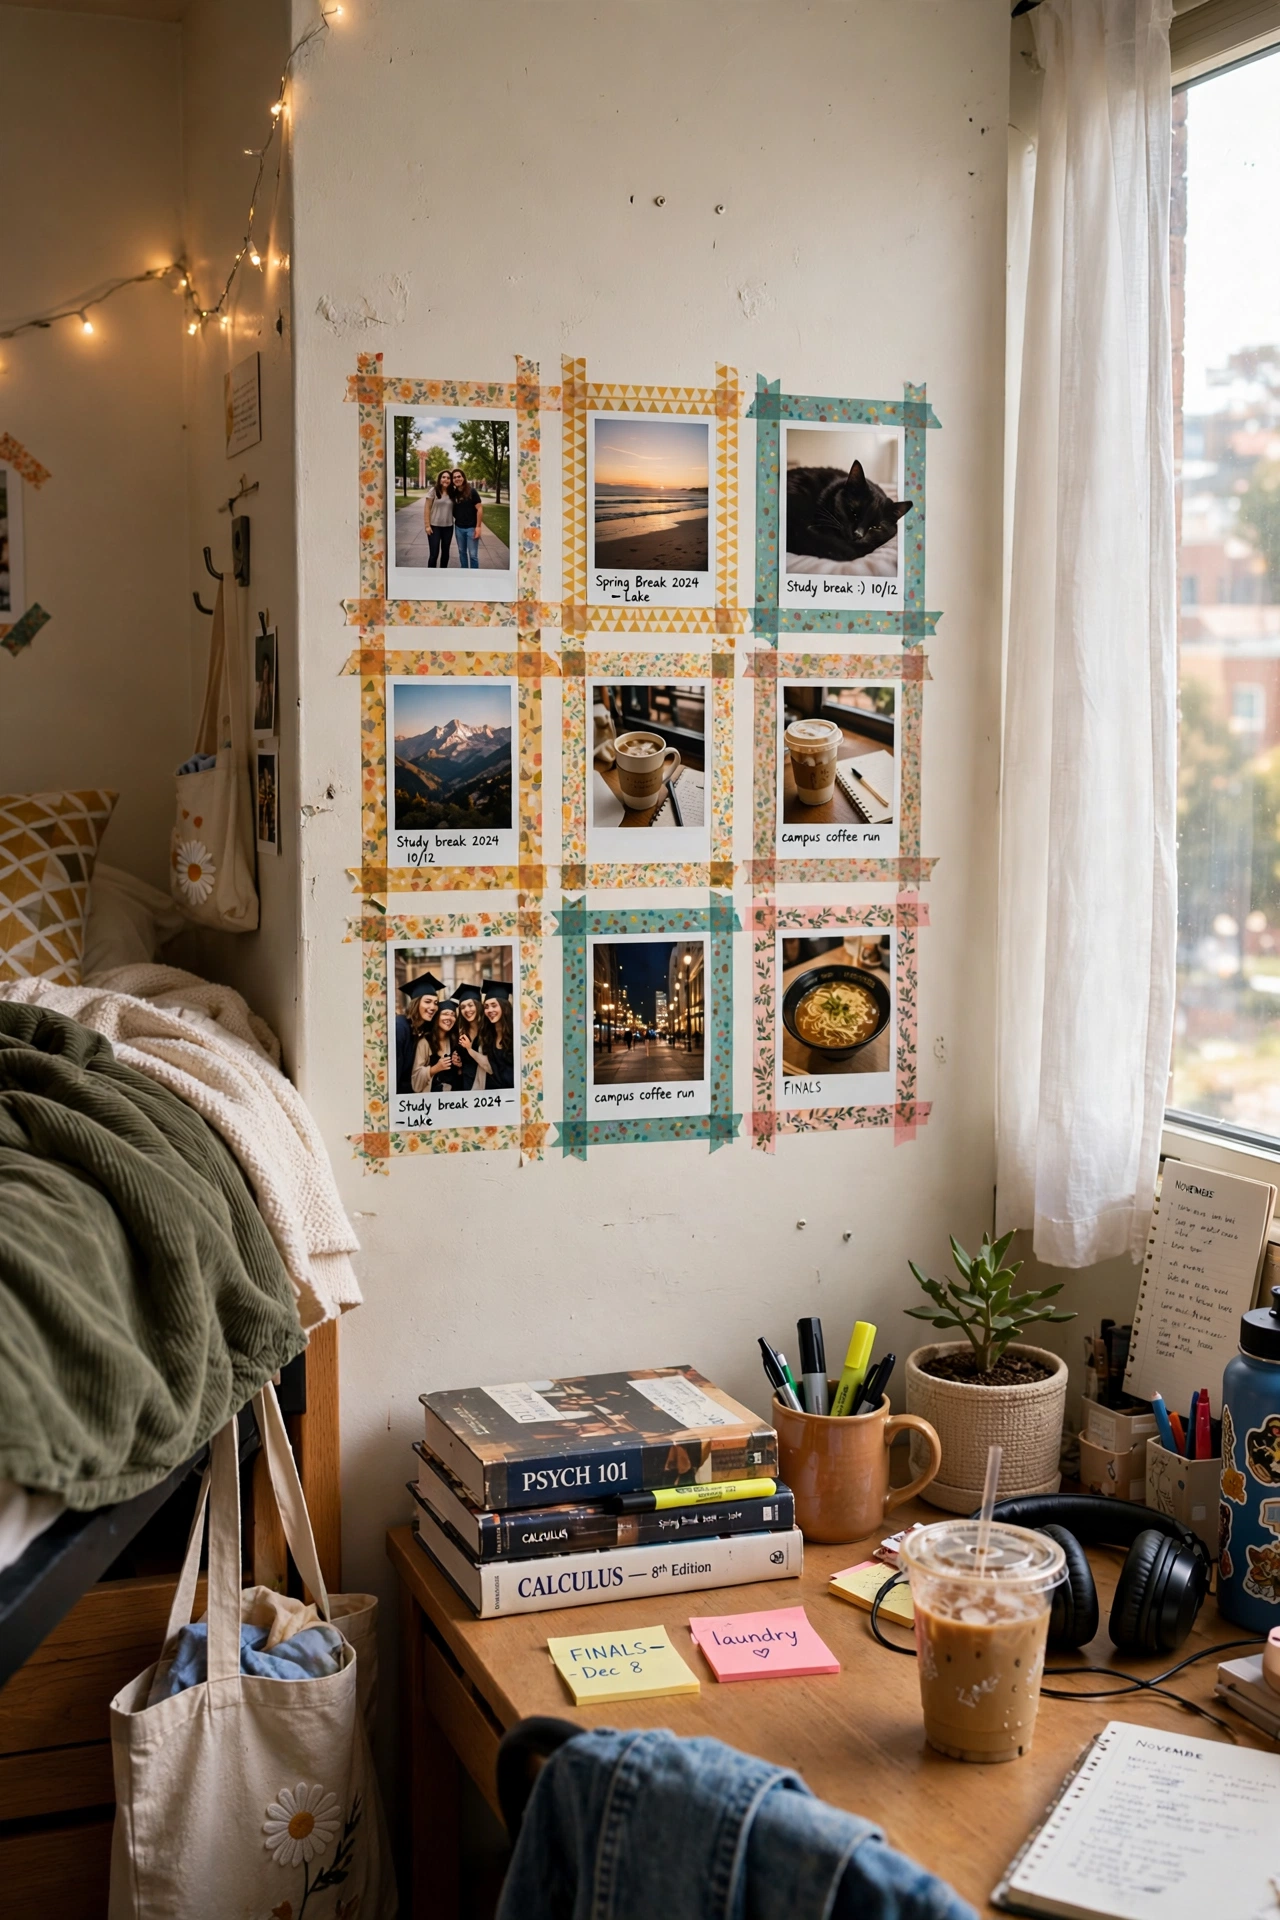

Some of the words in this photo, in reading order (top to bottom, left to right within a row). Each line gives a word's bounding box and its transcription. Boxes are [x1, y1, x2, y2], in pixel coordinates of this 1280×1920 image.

[595, 574, 630, 592] Spring
[635, 575, 667, 588] Break
[671, 577, 700, 589] 2024
[786, 579, 818, 598] Study
[823, 580, 854, 594] break
[871, 580, 899, 597] 10/12
[396, 834, 430, 853] Study
[435, 834, 467, 848] break
[472, 834, 500, 847] 2024
[781, 833, 821, 848] campus
[825, 829, 858, 843] coffee
[863, 833, 881, 843] run
[407, 850, 436, 868] 10/12
[594, 1092, 635, 1107] campus
[639, 1086, 672, 1101] coffee
[676, 1088, 695, 1100] run
[784, 1080, 822, 1096] FINALS
[398, 1097, 432, 1116] Study
[437, 1097, 469, 1111] break
[473, 1095, 502, 1109] 2024
[521, 1463, 592, 1493] PSYCH
[597, 1460, 629, 1486] 101
[517, 1566, 624, 1599] CALCULUS
[651, 1563, 669, 1580] 8th
[671, 1561, 713, 1577] Edition
[711, 1627, 798, 1647] laundry
[629, 1660, 643, 1674] 8
